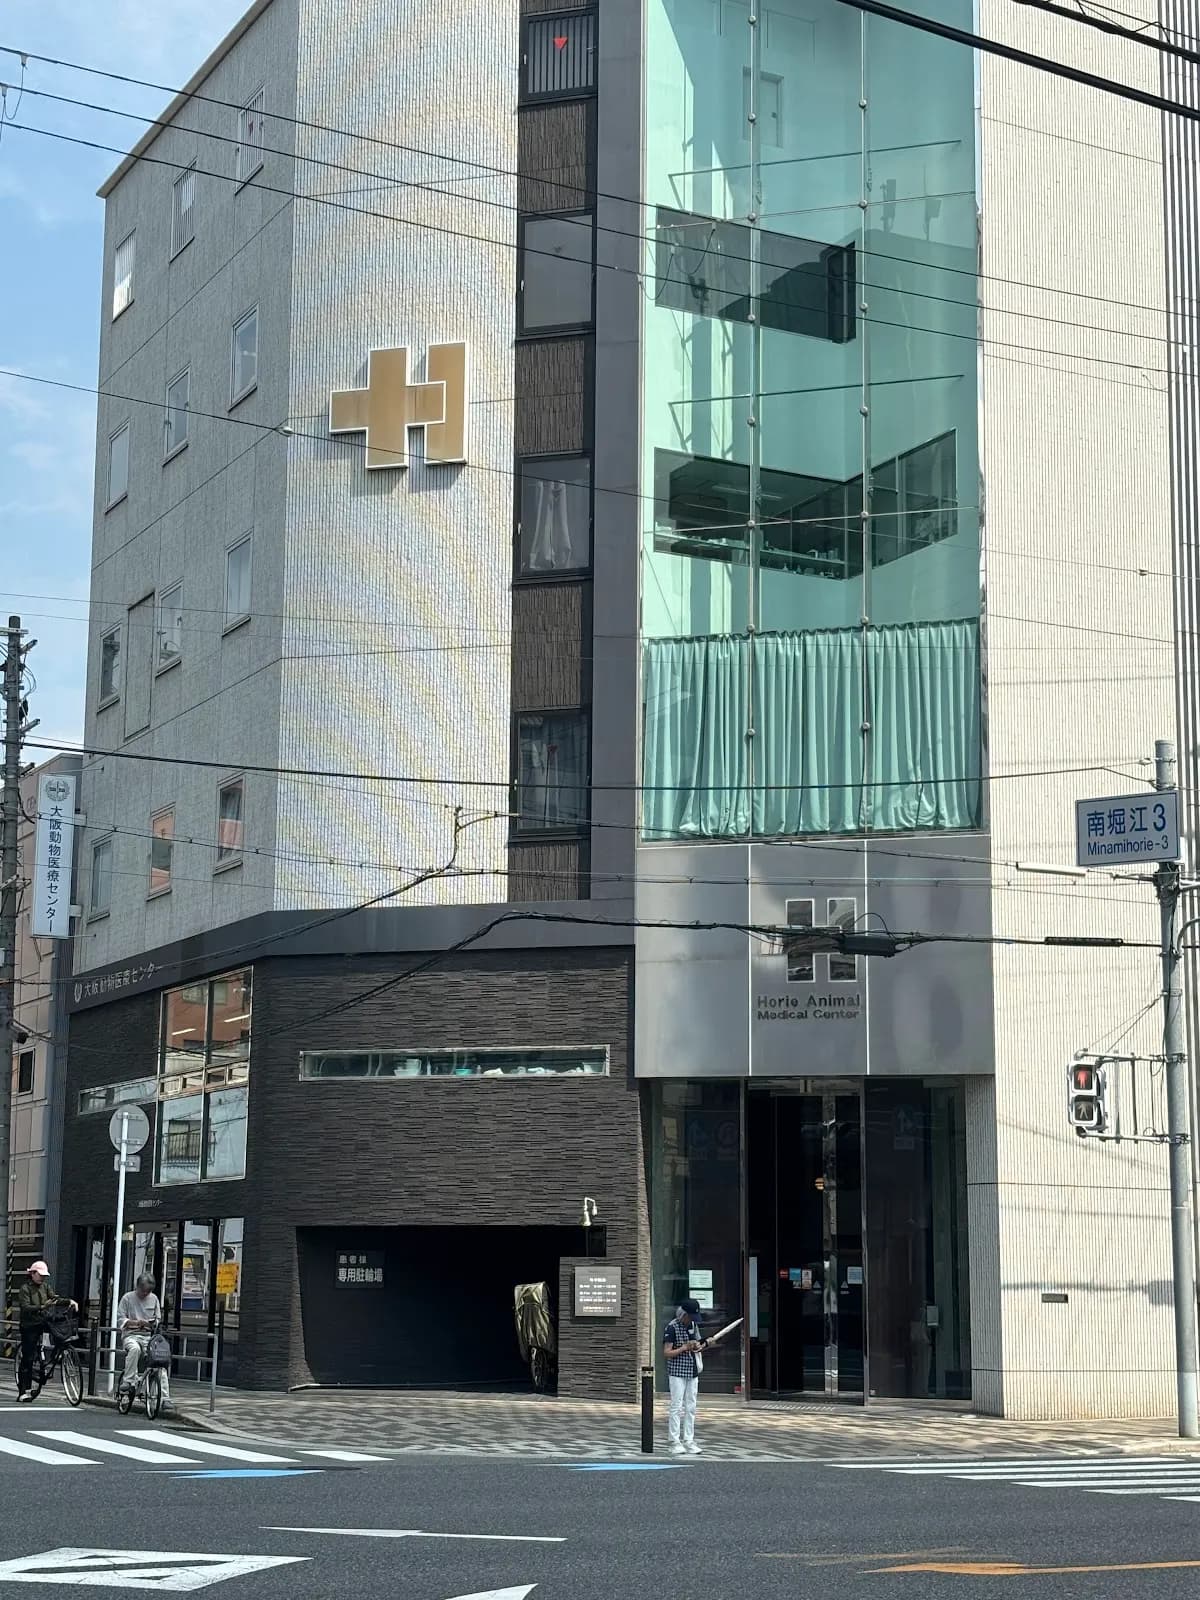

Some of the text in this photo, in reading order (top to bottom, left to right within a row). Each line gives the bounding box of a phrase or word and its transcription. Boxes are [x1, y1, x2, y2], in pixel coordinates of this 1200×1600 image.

[1086, 803, 1167, 838] 南堀江3
[1087, 835, 1169, 856] Minamihorie-3
[46, 805, 63, 932] 大阪動物医療センター
[757, 994, 860, 1008] Horie Animal
[757, 1009, 859, 1020] Medical Center
[337, 1267, 384, 1282] 専用駐輪場
